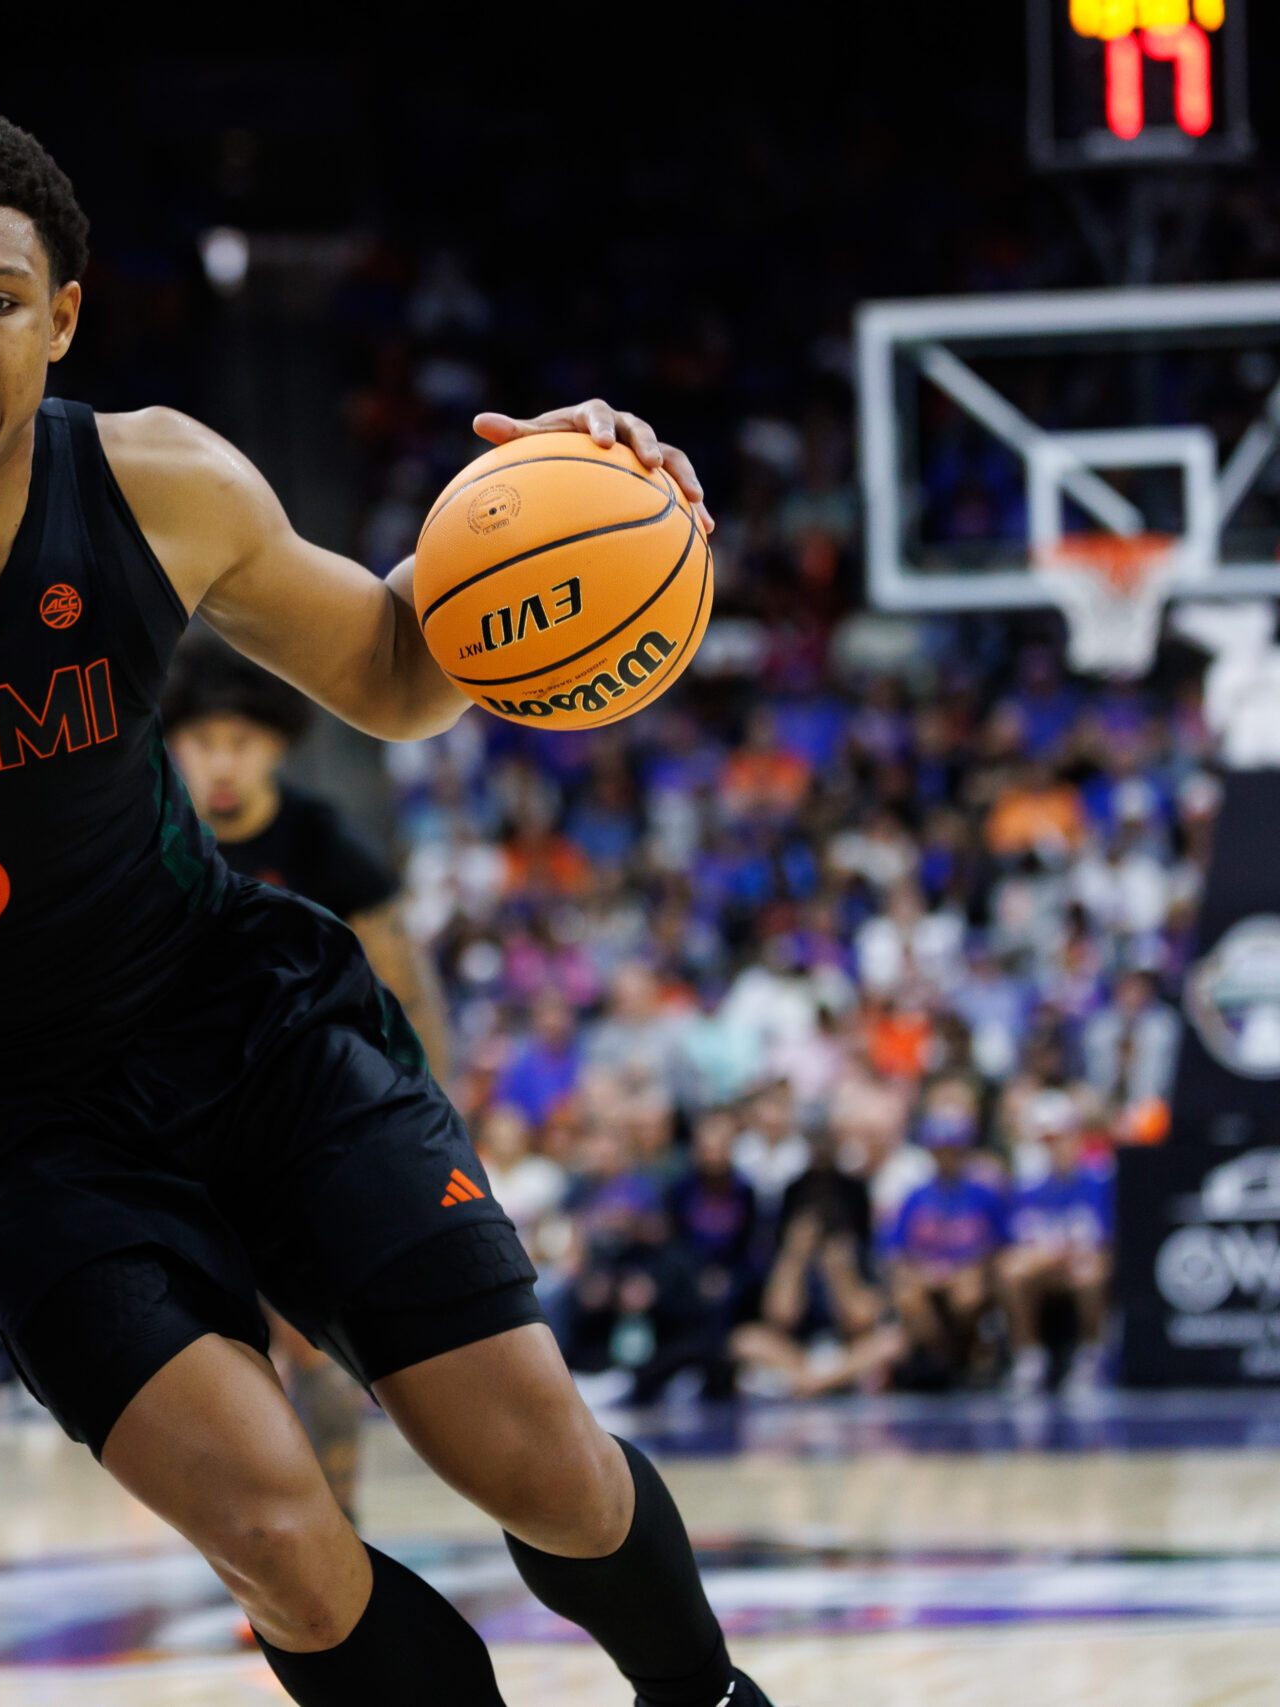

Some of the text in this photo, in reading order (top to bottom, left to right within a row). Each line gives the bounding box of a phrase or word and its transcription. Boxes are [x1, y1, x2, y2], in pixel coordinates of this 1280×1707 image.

[45, 595, 78, 612] ACC
[458, 576, 583, 660] EVO NXT
[481, 629, 678, 718] Wilson
[575, 657, 608, 680] INDOOR
[547, 679, 572, 691] GAME
